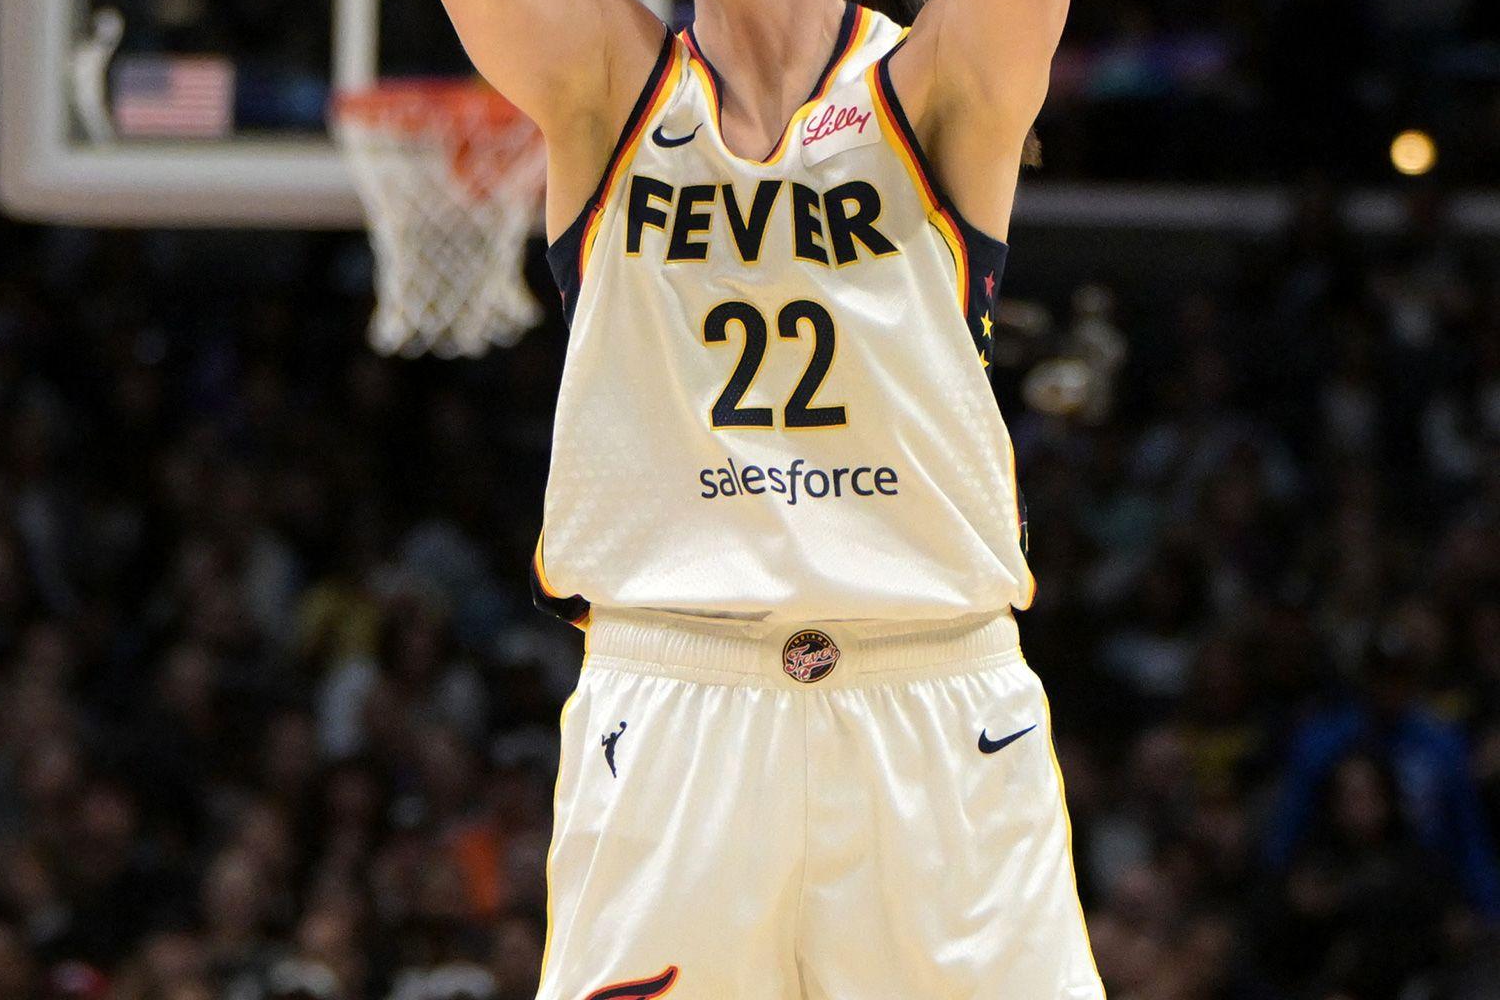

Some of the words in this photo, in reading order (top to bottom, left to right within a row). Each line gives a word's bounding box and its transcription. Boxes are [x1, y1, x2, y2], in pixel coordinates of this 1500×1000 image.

[802, 104, 872, 146] Lilly
[625, 174, 901, 270] FEVER
[703, 298, 850, 432] 22
[701, 458, 899, 505] salesforce
[784, 643, 840, 674] Fever
